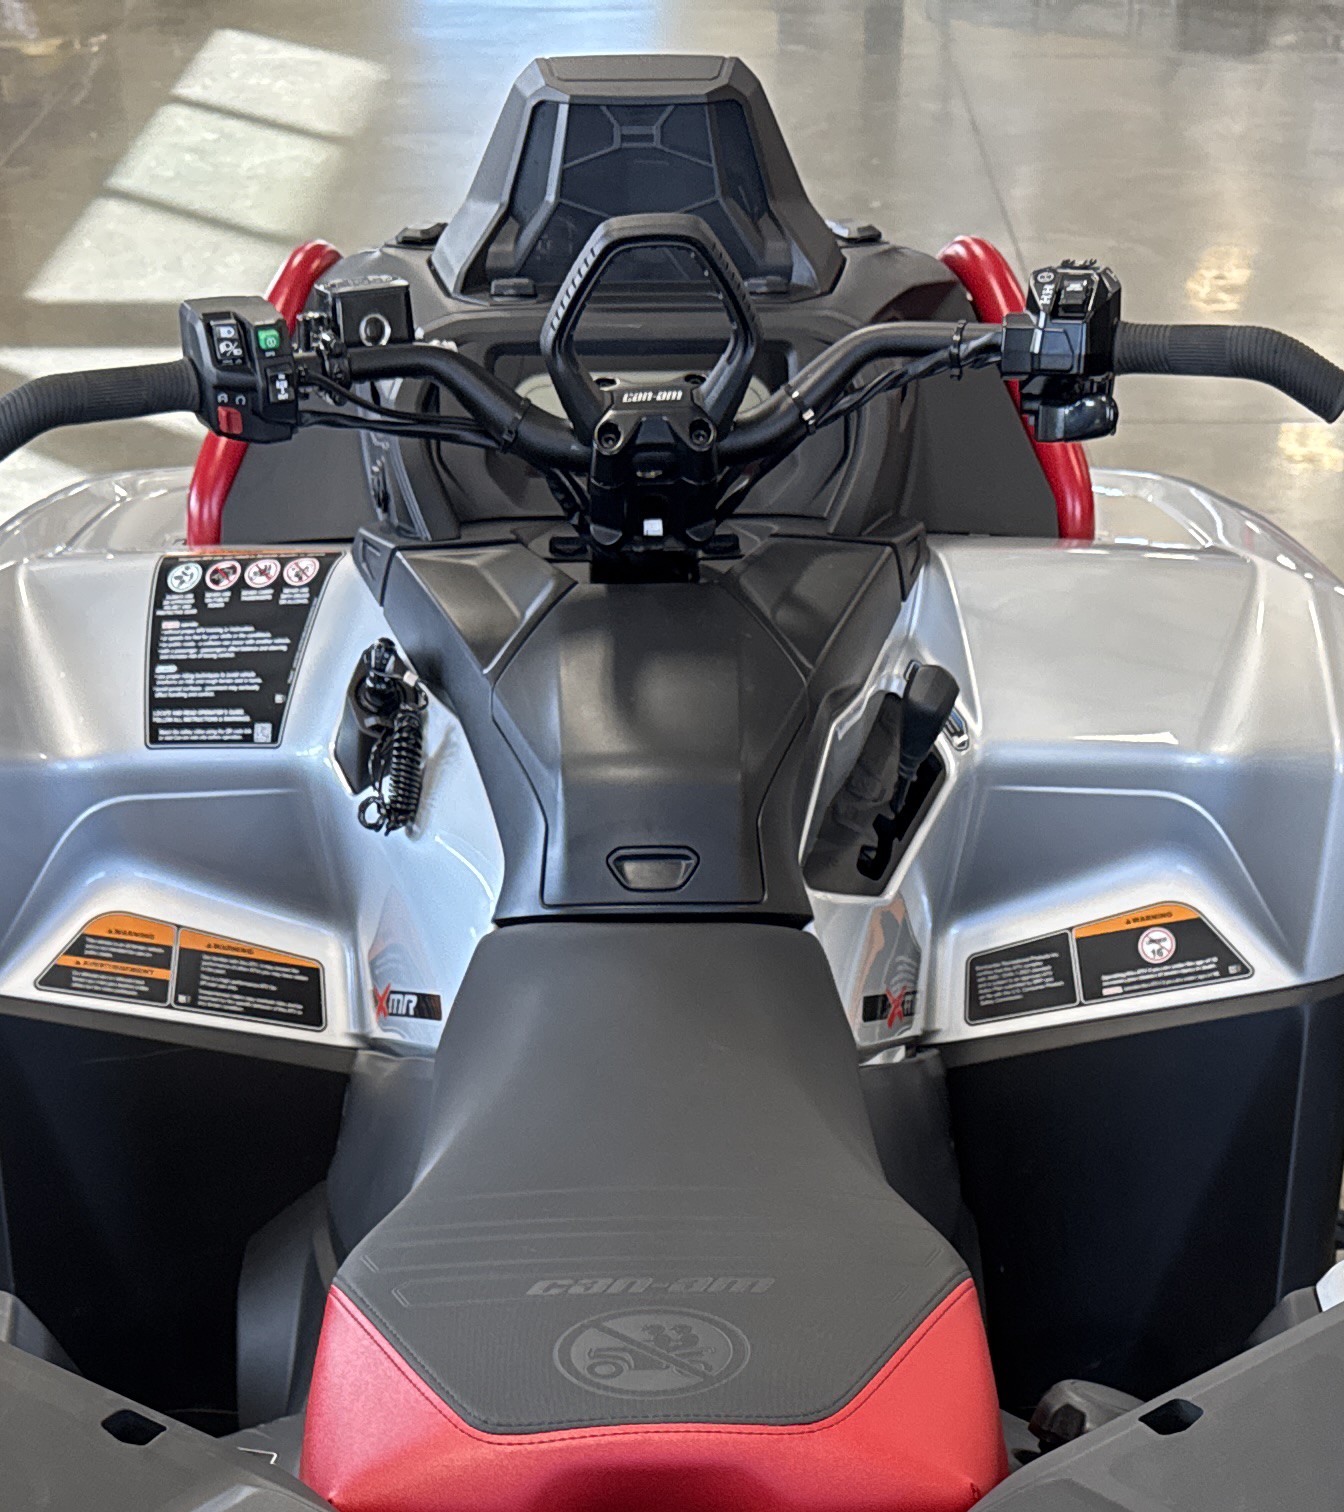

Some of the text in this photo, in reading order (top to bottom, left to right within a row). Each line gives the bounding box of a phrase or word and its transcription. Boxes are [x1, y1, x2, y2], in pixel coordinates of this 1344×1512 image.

[622, 389, 684, 403] can-am
[1150, 947, 1165, 960] 16
[525, 1275, 776, 1297] can-am
